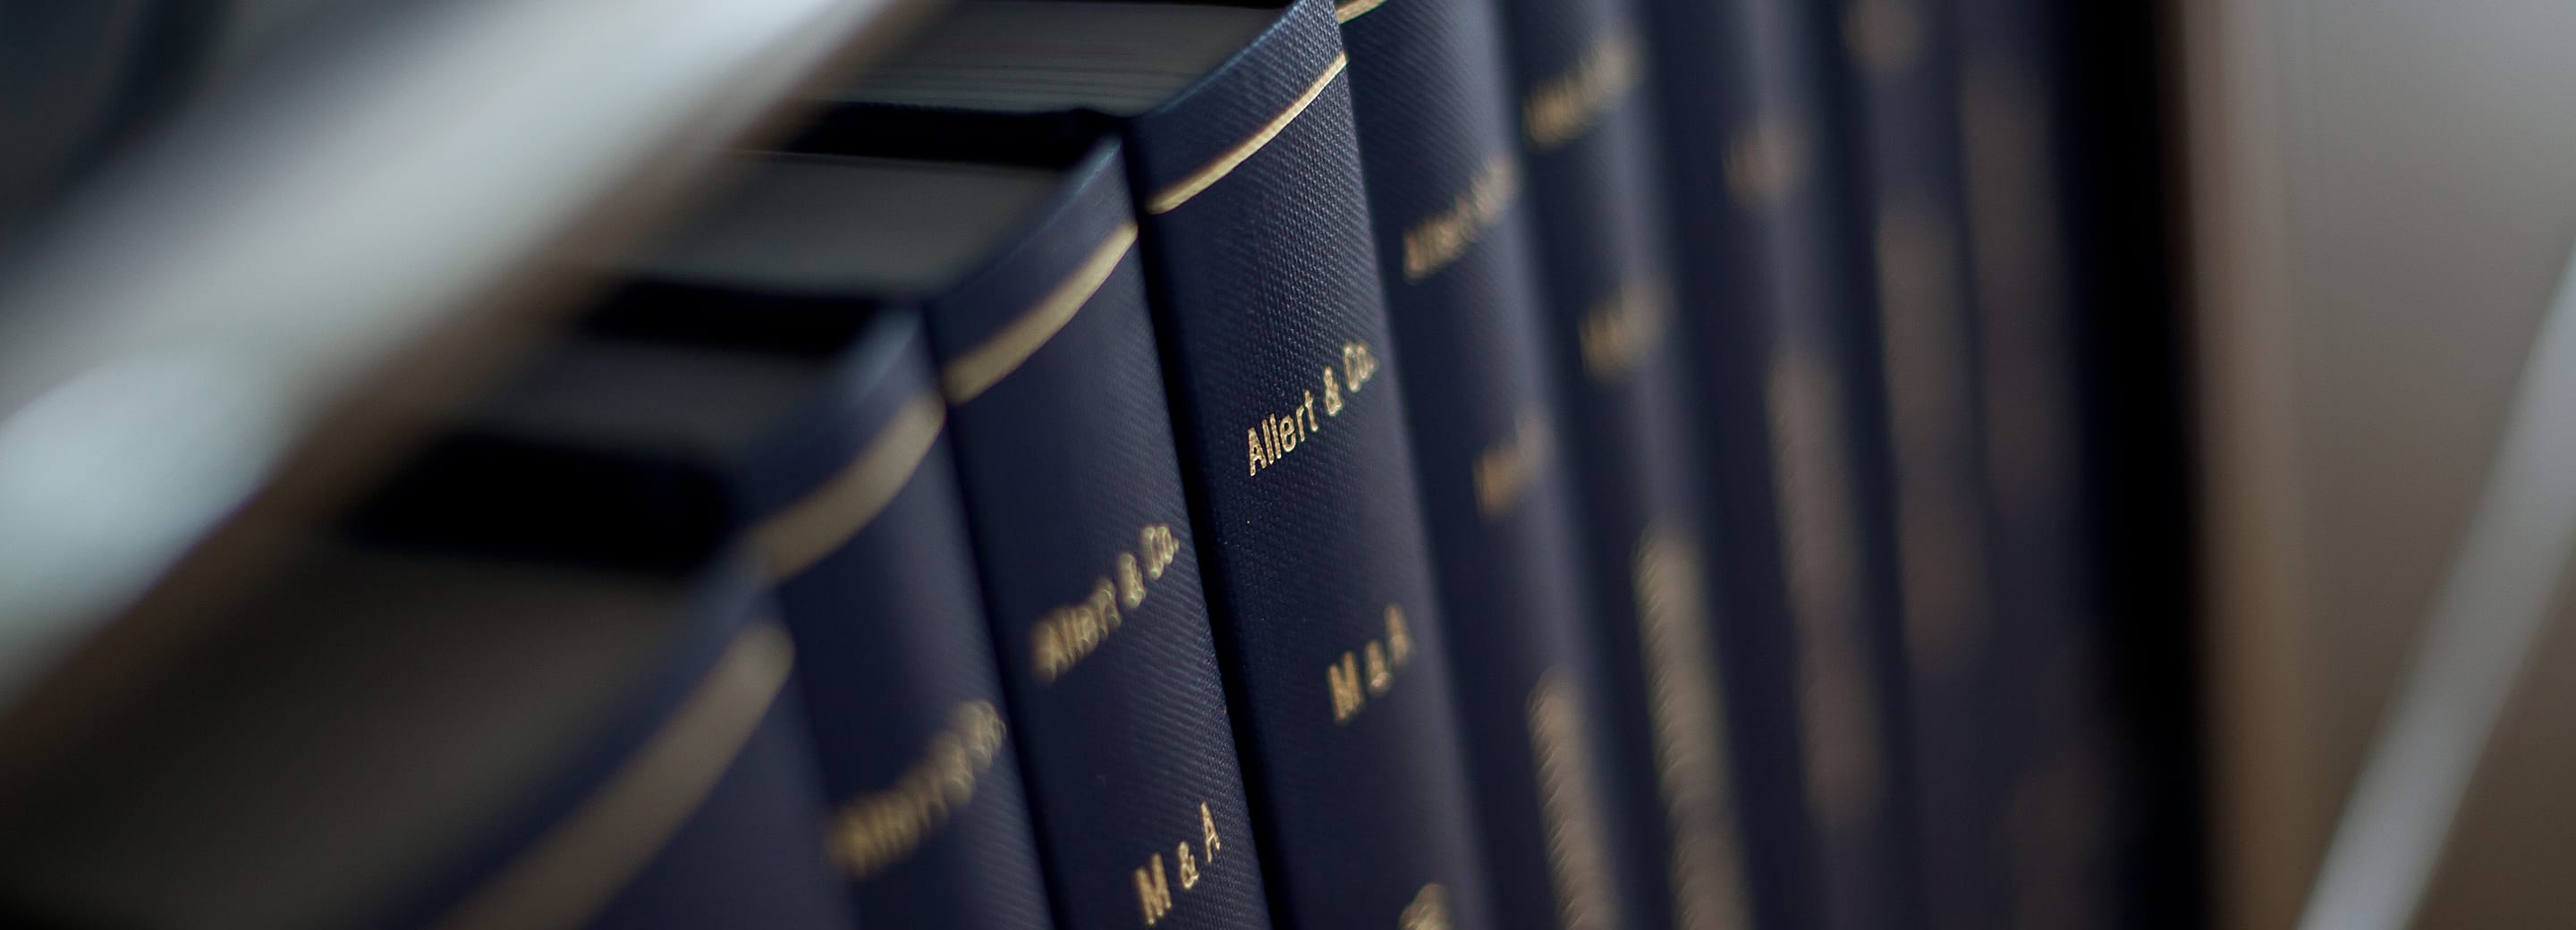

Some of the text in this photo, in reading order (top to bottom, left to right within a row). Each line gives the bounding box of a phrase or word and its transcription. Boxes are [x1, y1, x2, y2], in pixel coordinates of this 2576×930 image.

[1248, 342, 1378, 478] Allert & Co.
[1032, 579, 1122, 683] Allert
[1117, 552, 1146, 608] &
[1329, 651, 1364, 722] M
[1134, 801, 1221, 926] M & A
